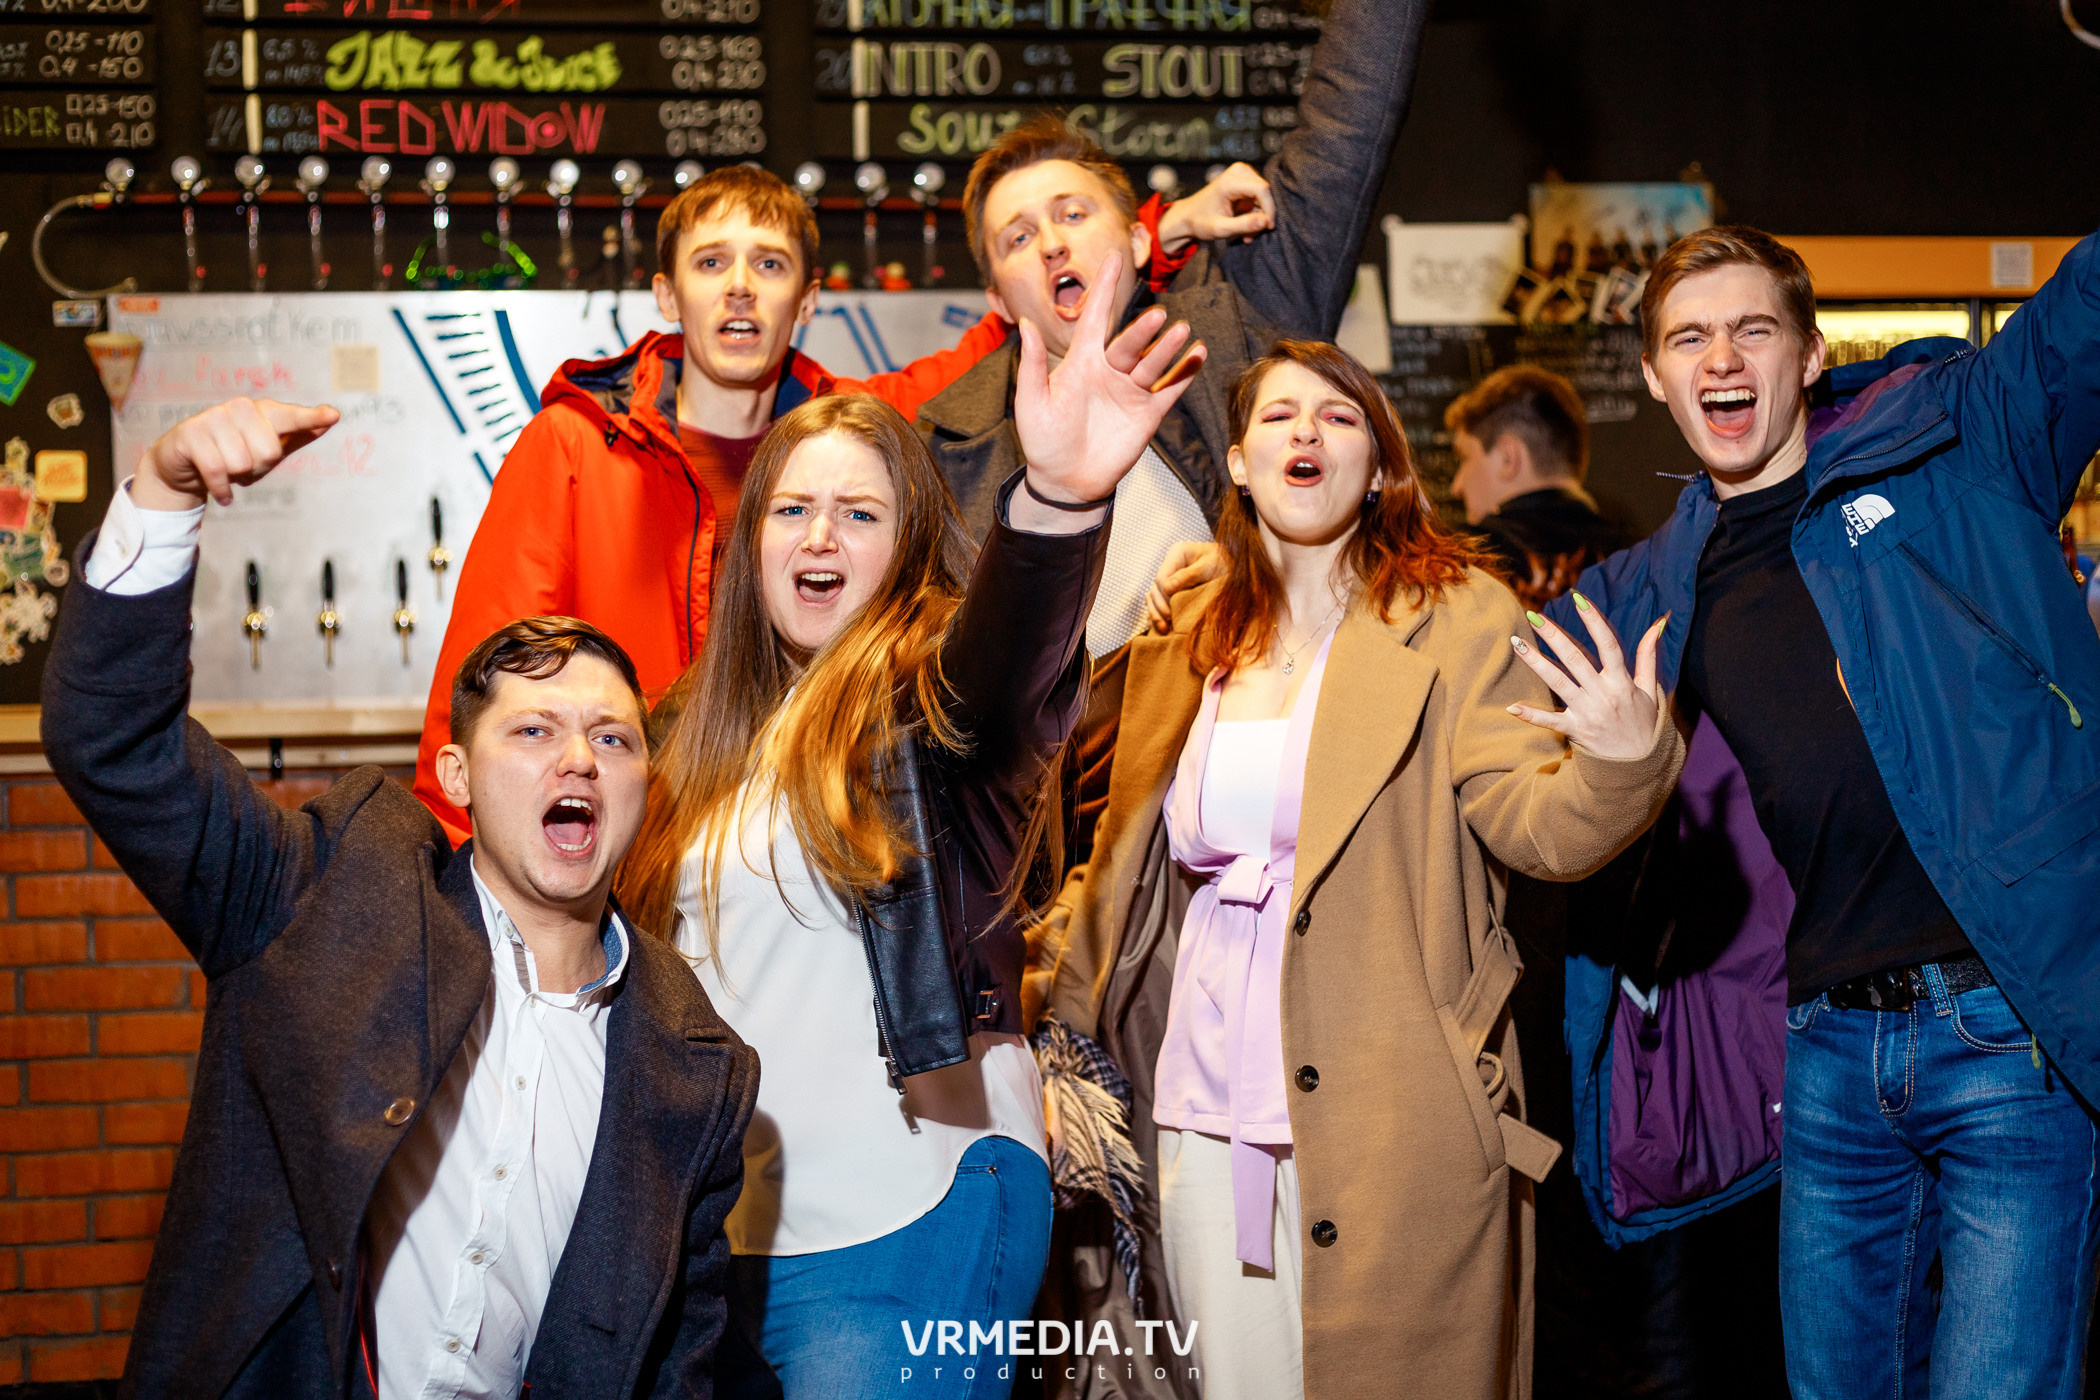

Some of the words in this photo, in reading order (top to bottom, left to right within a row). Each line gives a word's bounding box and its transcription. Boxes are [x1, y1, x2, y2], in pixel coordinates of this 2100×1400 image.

[204, 40, 241, 78] 13
[864, 41, 1001, 97] NTRO
[1102, 43, 1244, 98] STOUT
[316, 99, 436, 156] RED
[440, 100, 606, 156] WIDOW
